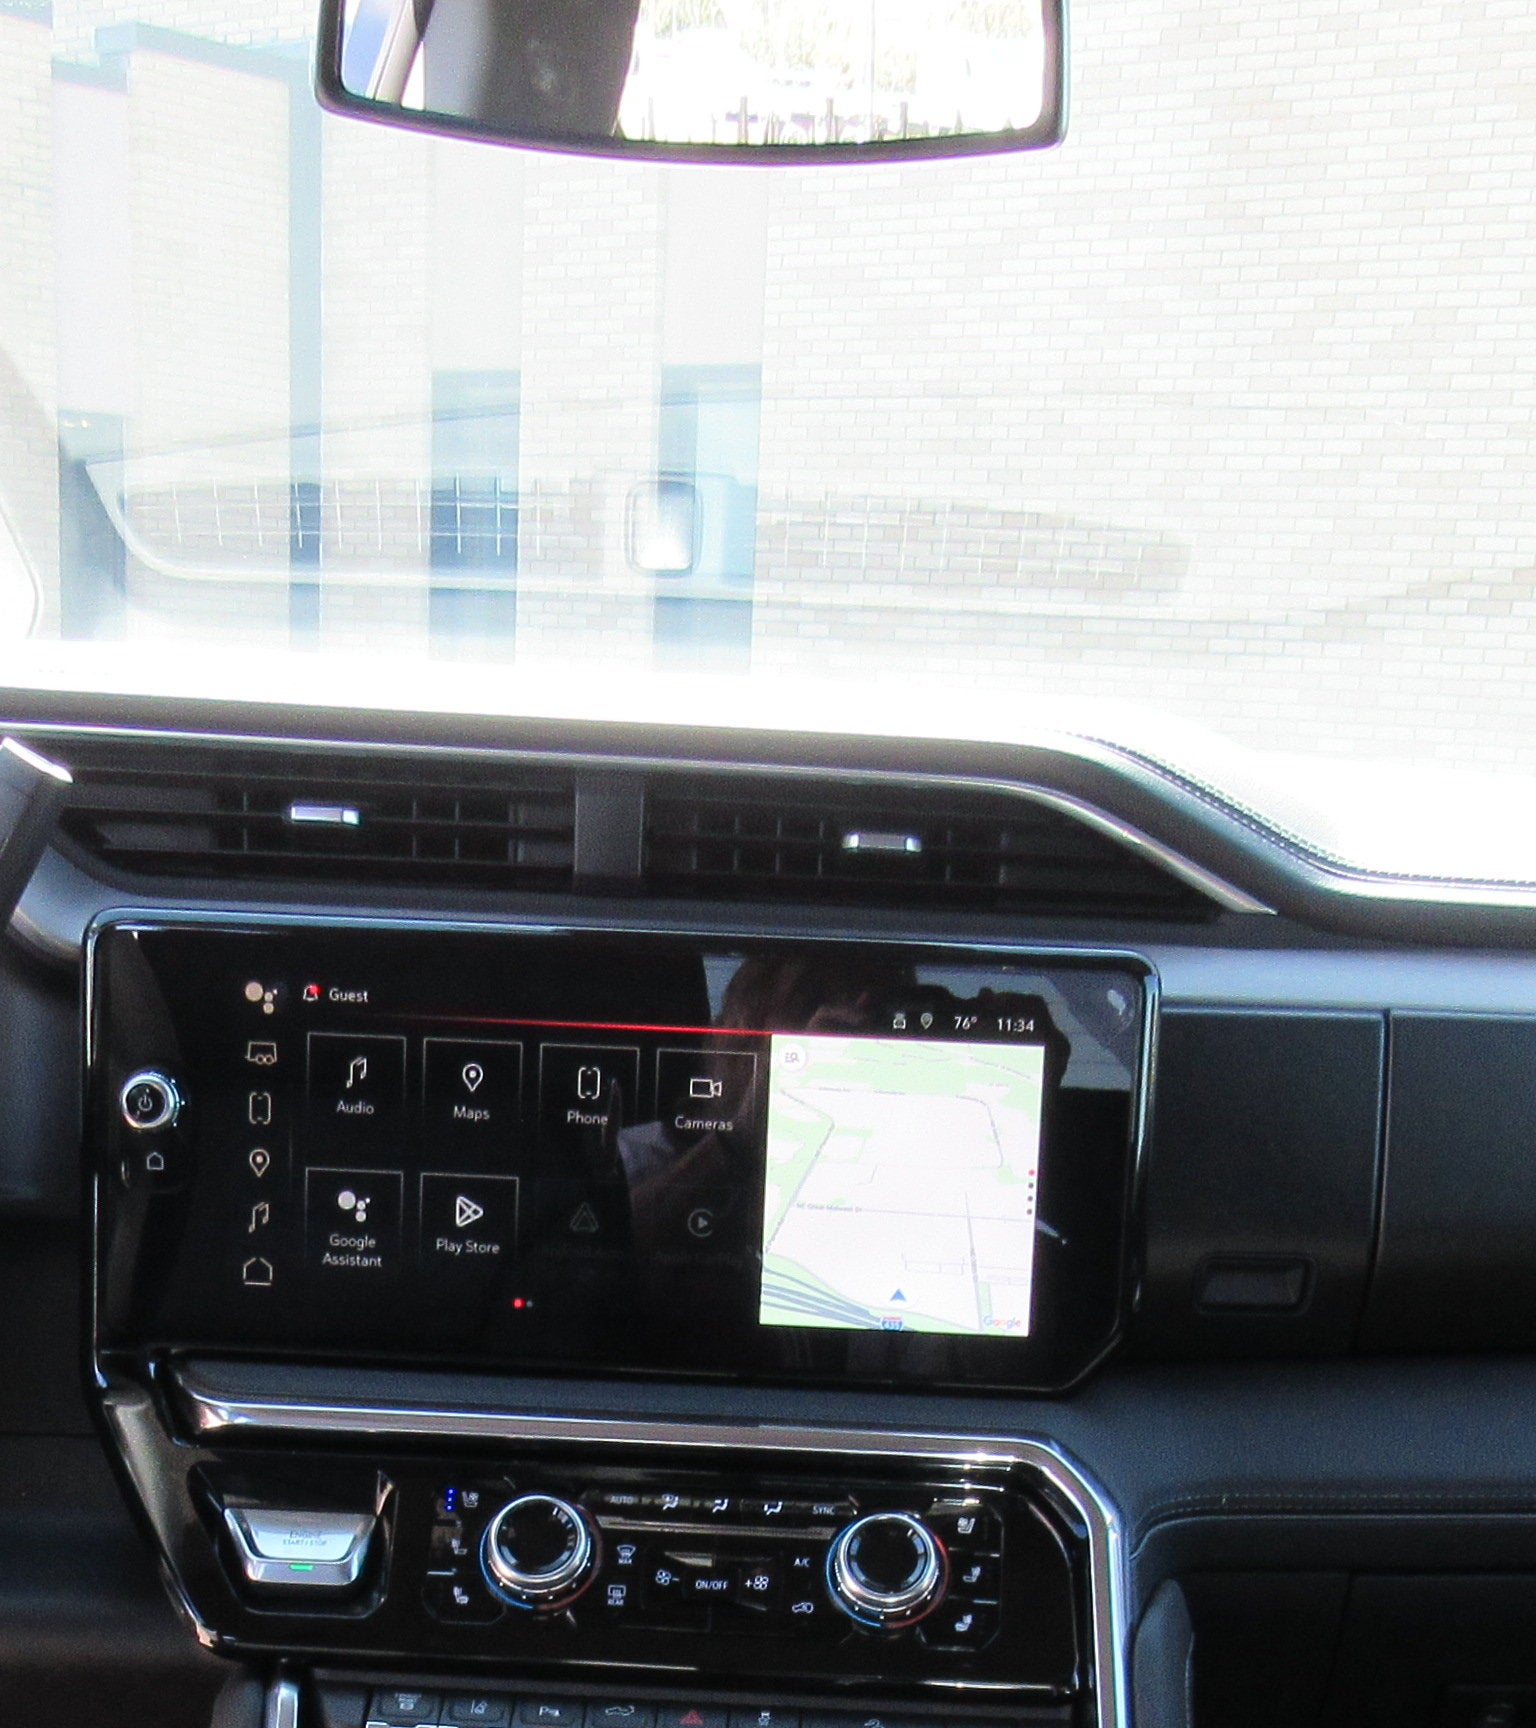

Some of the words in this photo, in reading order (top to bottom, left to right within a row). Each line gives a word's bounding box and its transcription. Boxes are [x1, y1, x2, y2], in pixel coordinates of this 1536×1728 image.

[328, 987, 369, 1003] Guest
[997, 1017, 1035, 1032] 11:34
[336, 1100, 375, 1115] Audio
[453, 1105, 491, 1122] Maps
[566, 1110, 609, 1126] Phone
[674, 1115, 734, 1132] Cameras
[328, 1233, 376, 1251] Google
[435, 1238, 463, 1256] Play
[465, 1239, 500, 1255] Store
[321, 1252, 383, 1268] Assistant
[982, 1314, 1021, 1329] Google
[610, 1495, 635, 1505] AUTO
[812, 1505, 836, 1516] SYNC
[793, 1557, 810, 1568] A/C
[695, 1579, 728, 1590] ON/OFF
